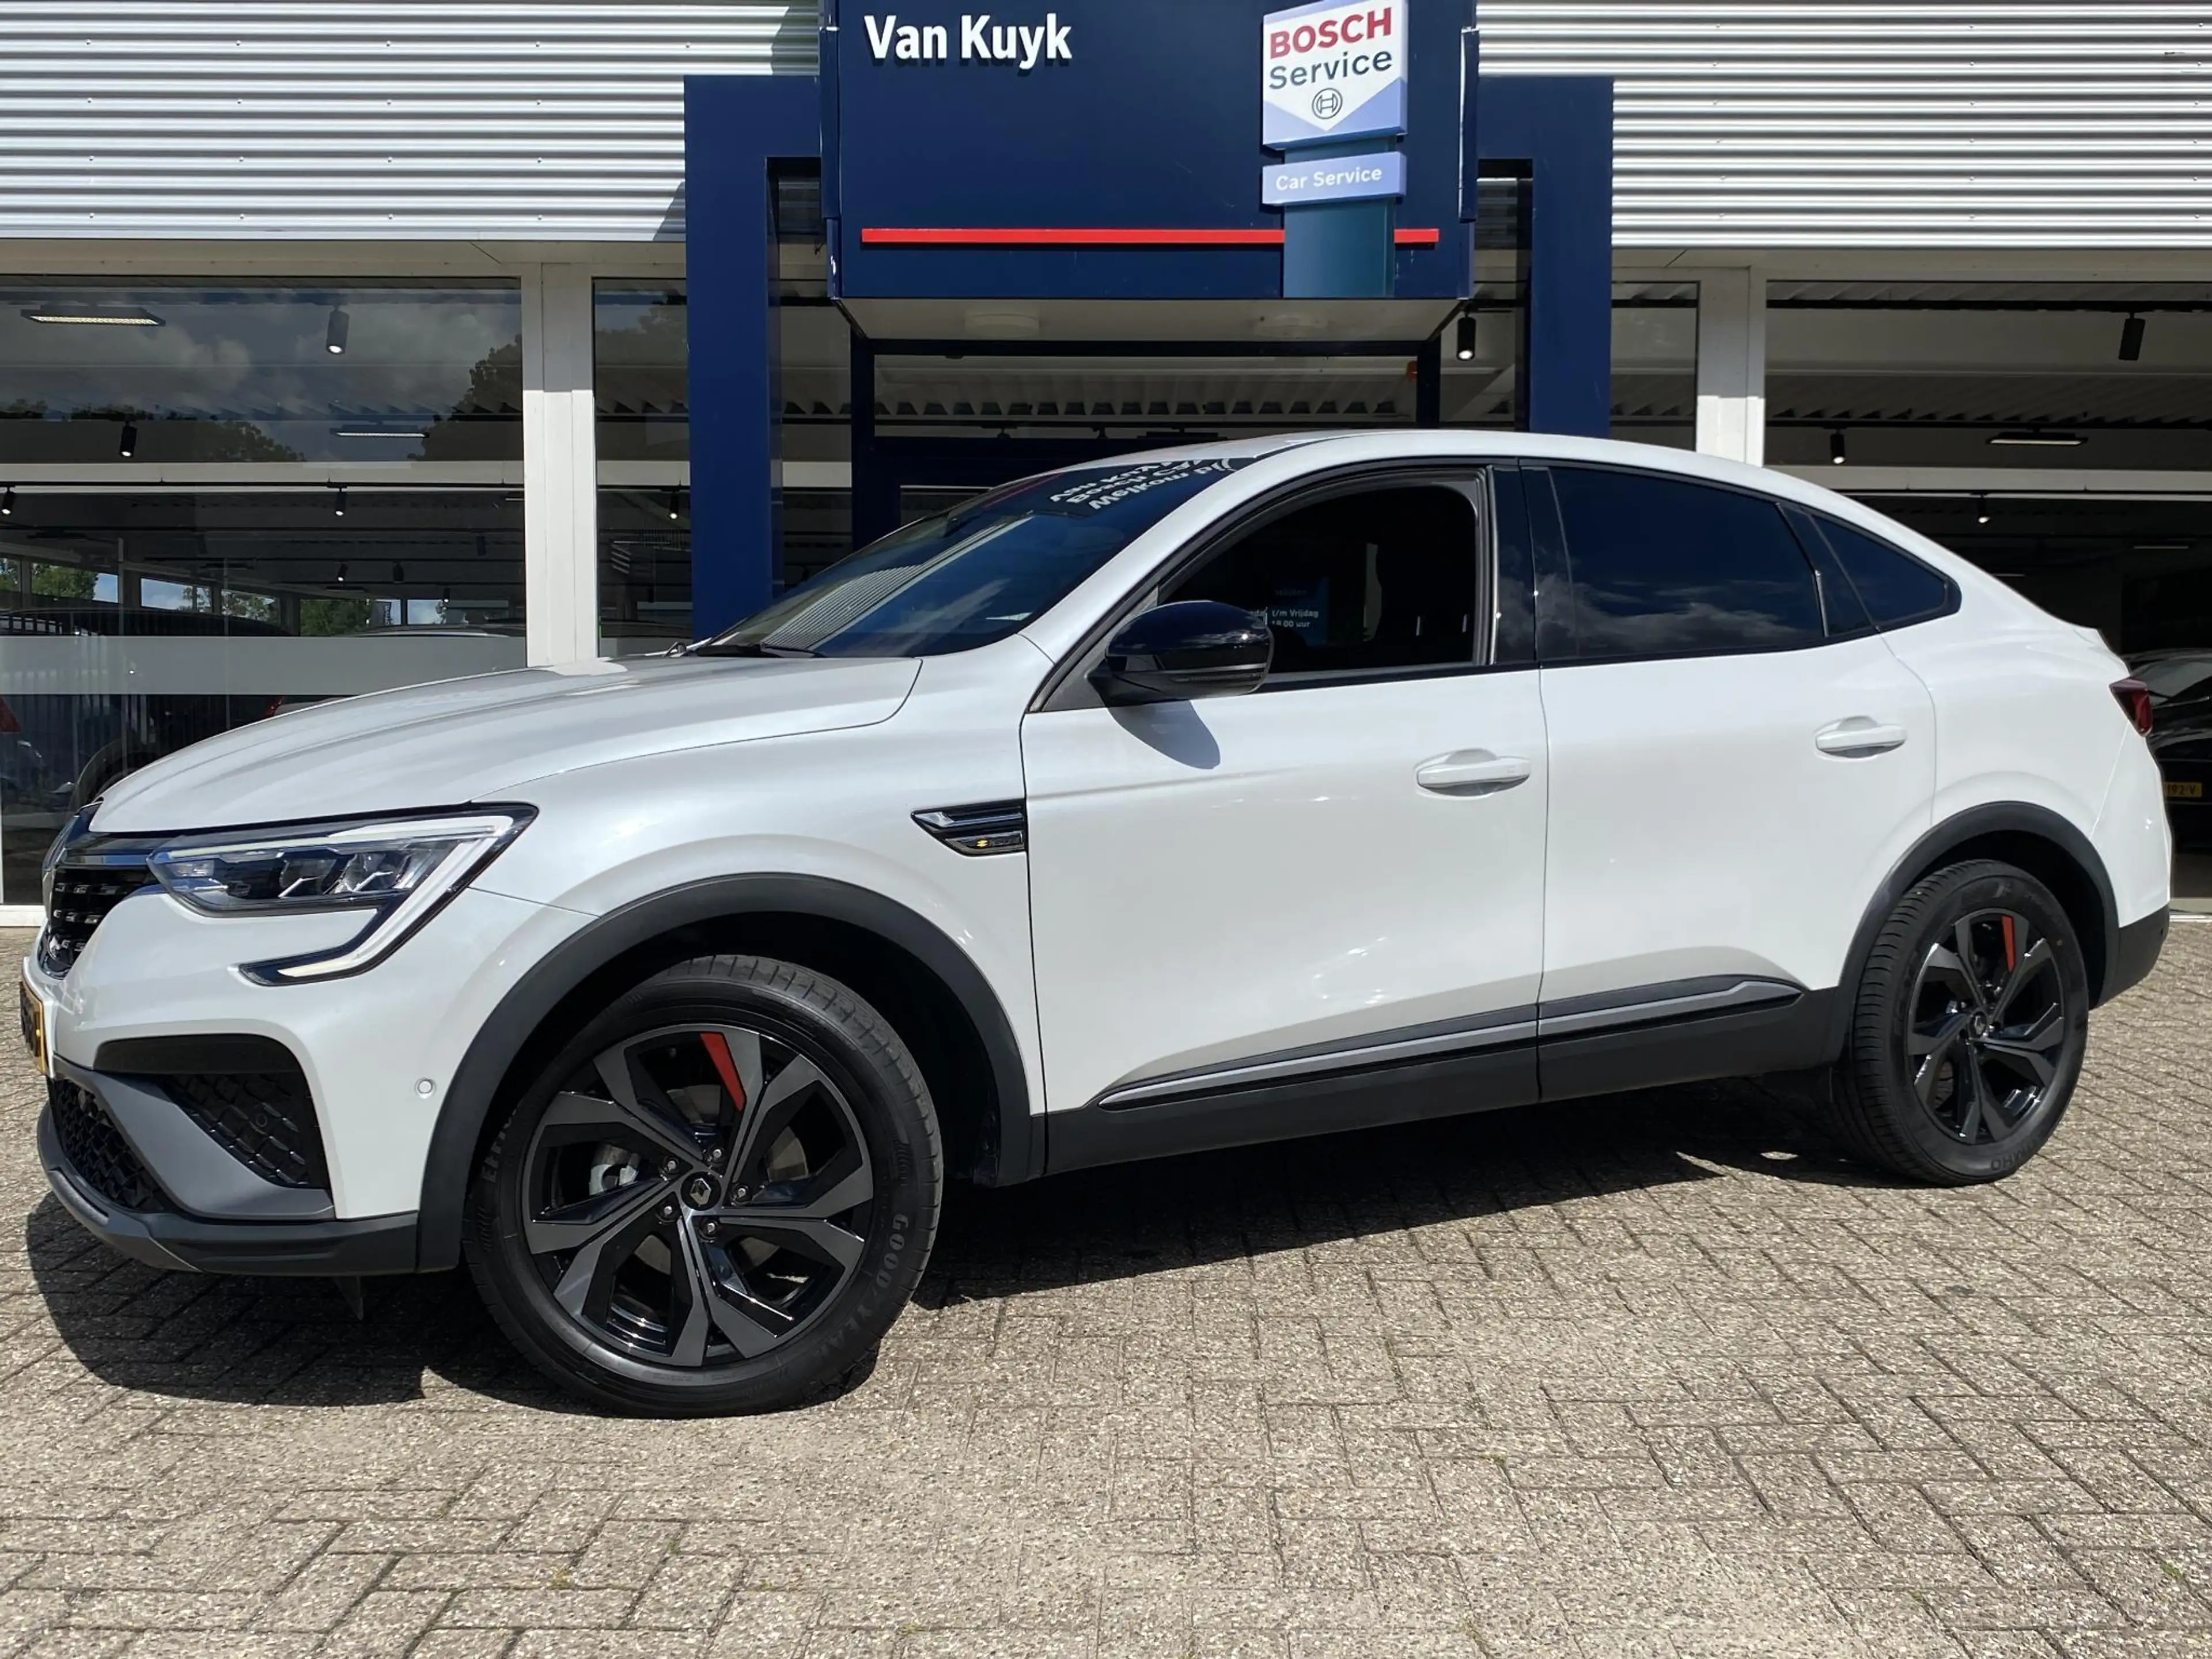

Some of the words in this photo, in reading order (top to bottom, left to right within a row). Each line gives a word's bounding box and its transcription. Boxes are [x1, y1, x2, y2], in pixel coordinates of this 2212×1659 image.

[864, 15, 947, 59] Van
[961, 13, 1073, 70] Kuyk
[1270, 7, 1392, 59] BOSCH
[1269, 51, 1392, 90] Service
[1276, 175, 1307, 191] Car
[1313, 168, 1382, 187] Service
[1289, 608, 1320, 619] Vrijdag
